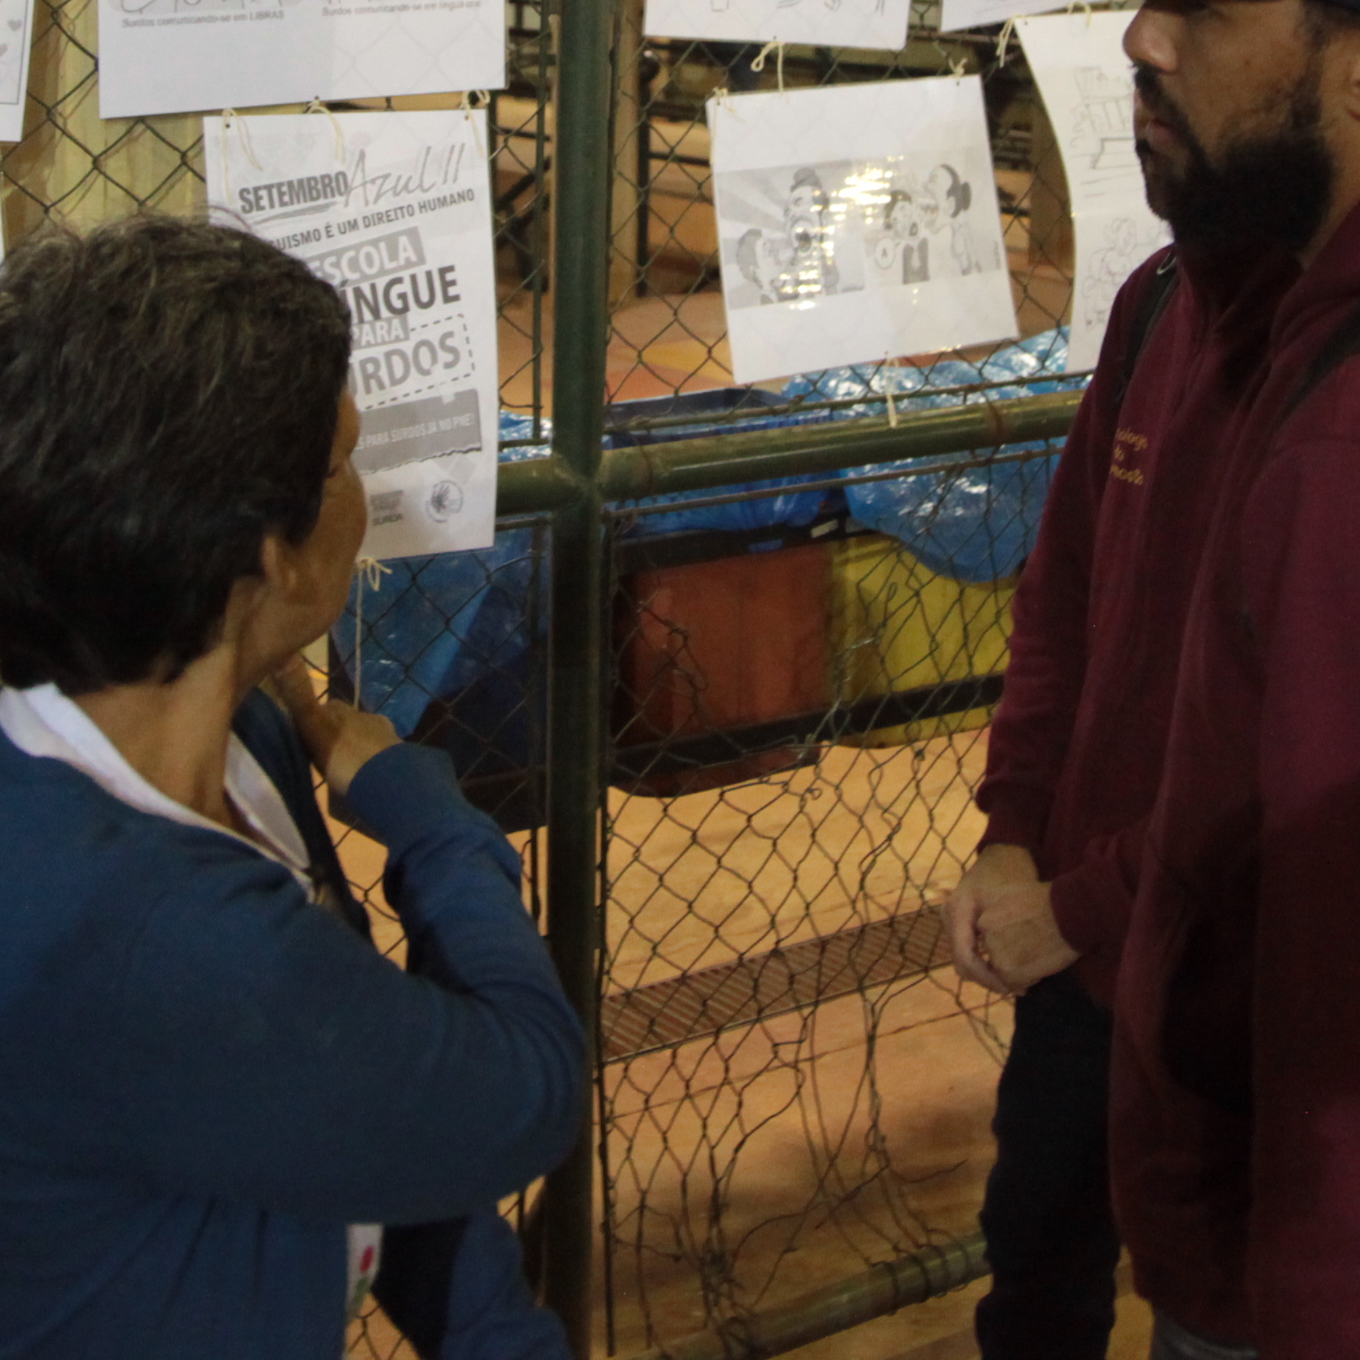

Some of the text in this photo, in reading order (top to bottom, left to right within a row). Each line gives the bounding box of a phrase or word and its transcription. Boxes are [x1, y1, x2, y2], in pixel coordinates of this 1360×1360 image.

[250, 10, 285, 21] LIBRAS
[238, 170, 349, 214] SETEMBRO
[325, 221, 335, 238] É
[337, 219, 359, 236] UM
[363, 203, 415, 228] DIREITO
[419, 188, 475, 214] HUMANO
